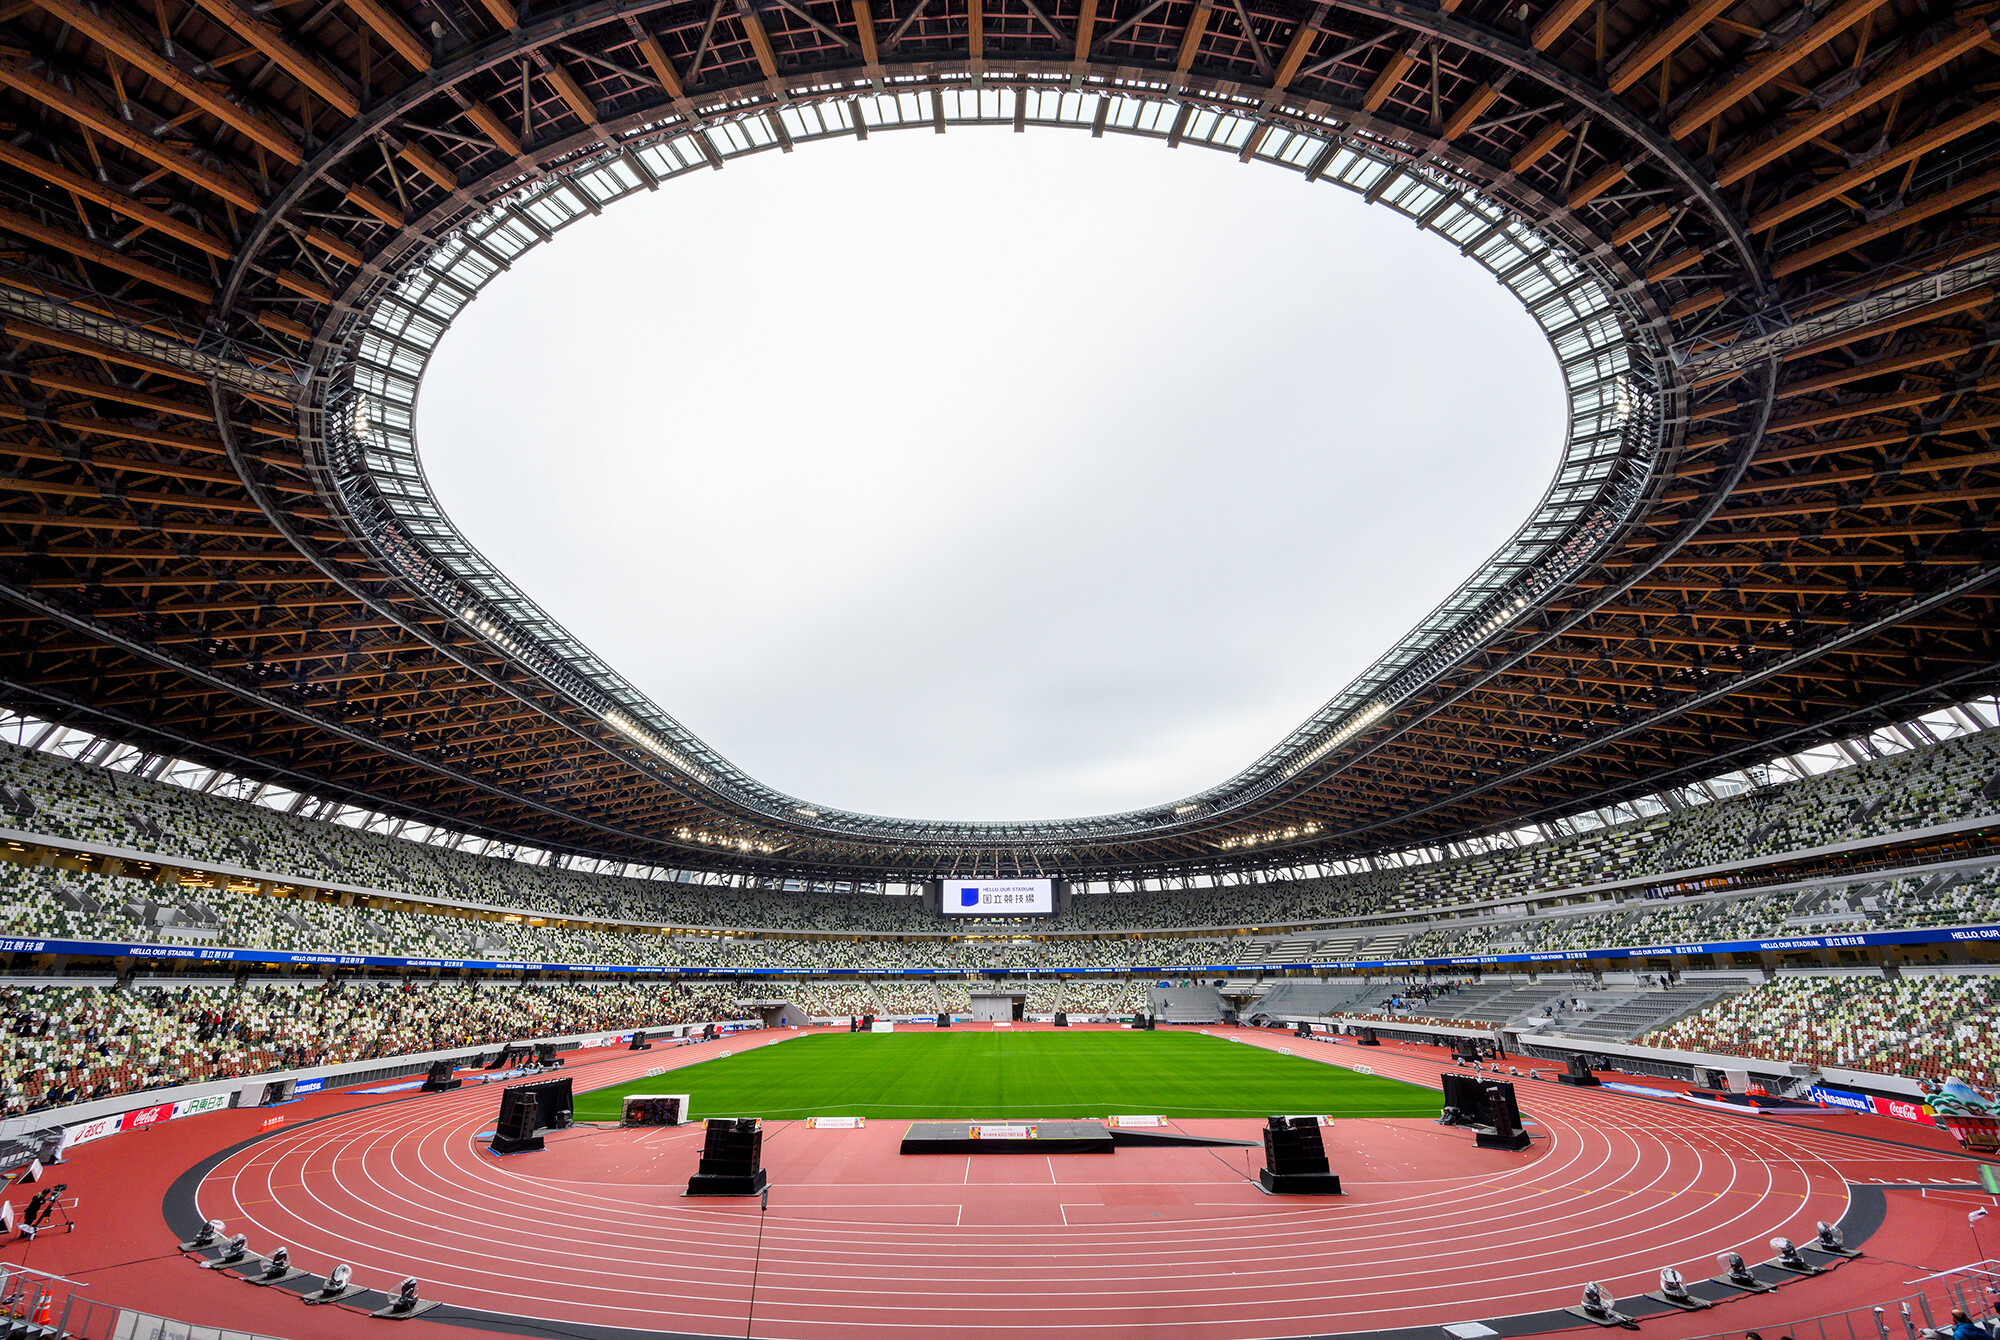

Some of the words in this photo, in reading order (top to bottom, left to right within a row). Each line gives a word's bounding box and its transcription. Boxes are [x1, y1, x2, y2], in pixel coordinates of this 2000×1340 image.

[1951, 931, 1980, 939] HELLO,
[1980, 929, 2000, 938] OUR
[1825, 936, 1866, 946] 国立競技場
[200, 950, 234, 958] 国立競技場
[294, 1082, 322, 1094] samitsu.
[183, 1096, 225, 1114] JR東日本
[84, 1121, 106, 1138] asics
